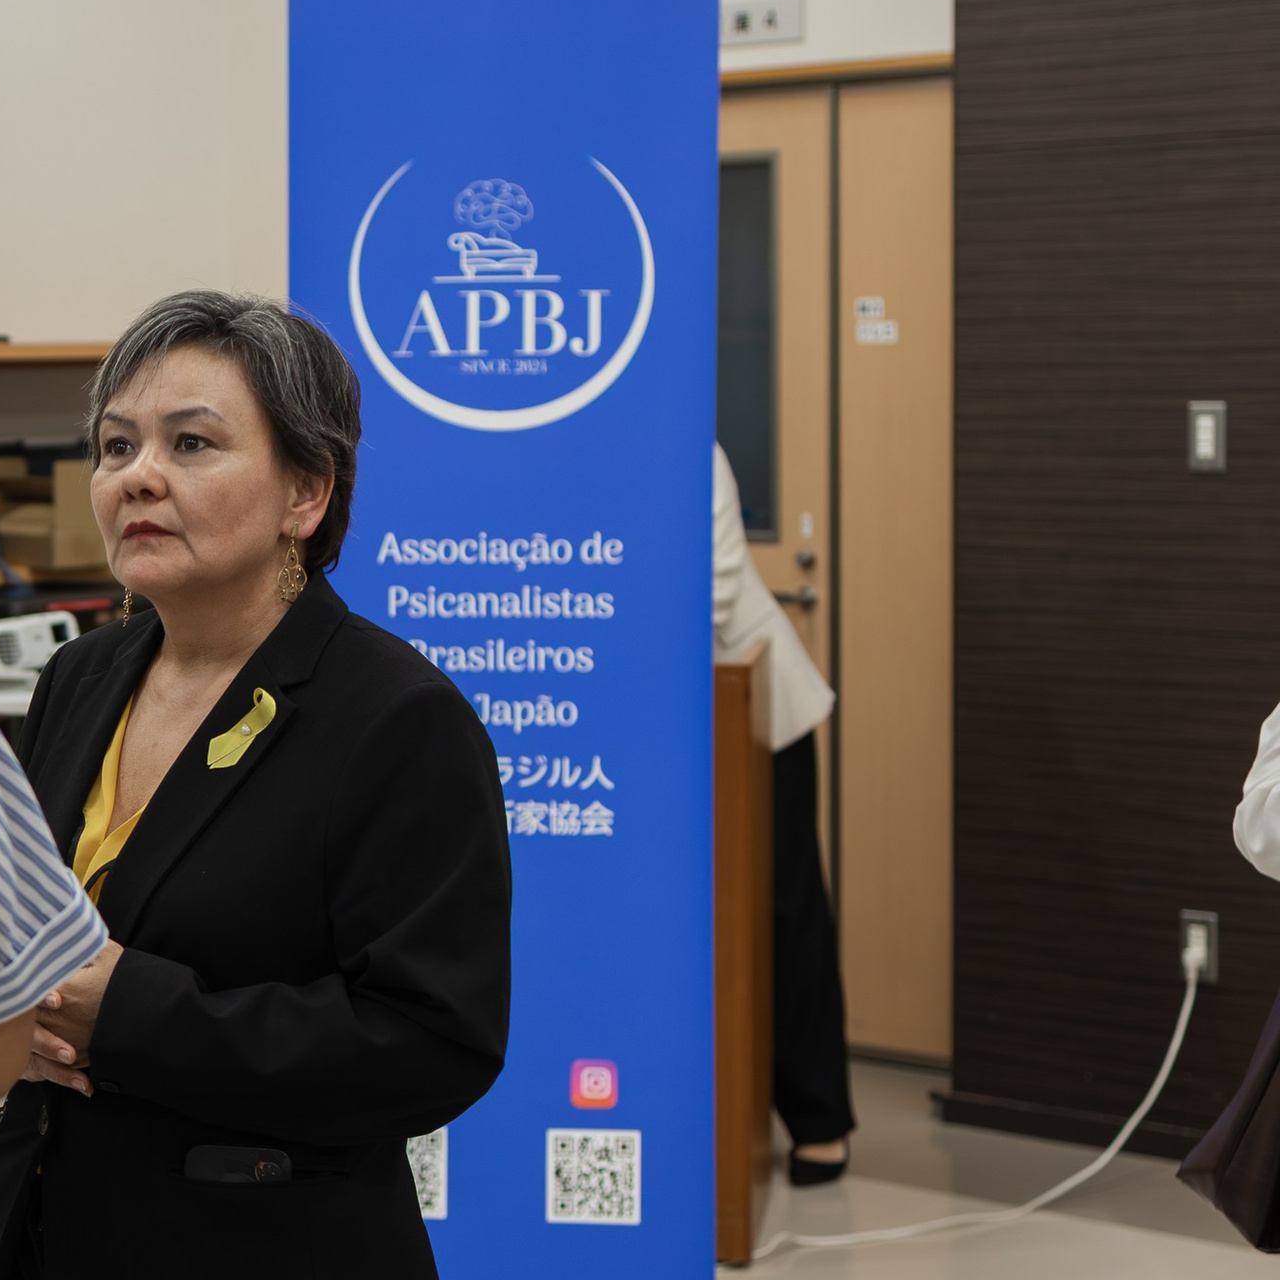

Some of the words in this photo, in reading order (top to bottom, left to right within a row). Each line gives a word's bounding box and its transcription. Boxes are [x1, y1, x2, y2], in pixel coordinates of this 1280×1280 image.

[391, 289, 611, 357] APBJ
[460, 358, 512, 375] SINCE
[376, 531, 573, 572] Associação
[580, 531, 624, 565] de
[387, 585, 615, 619] Psicanalistas
[473, 693, 578, 734] Japão
